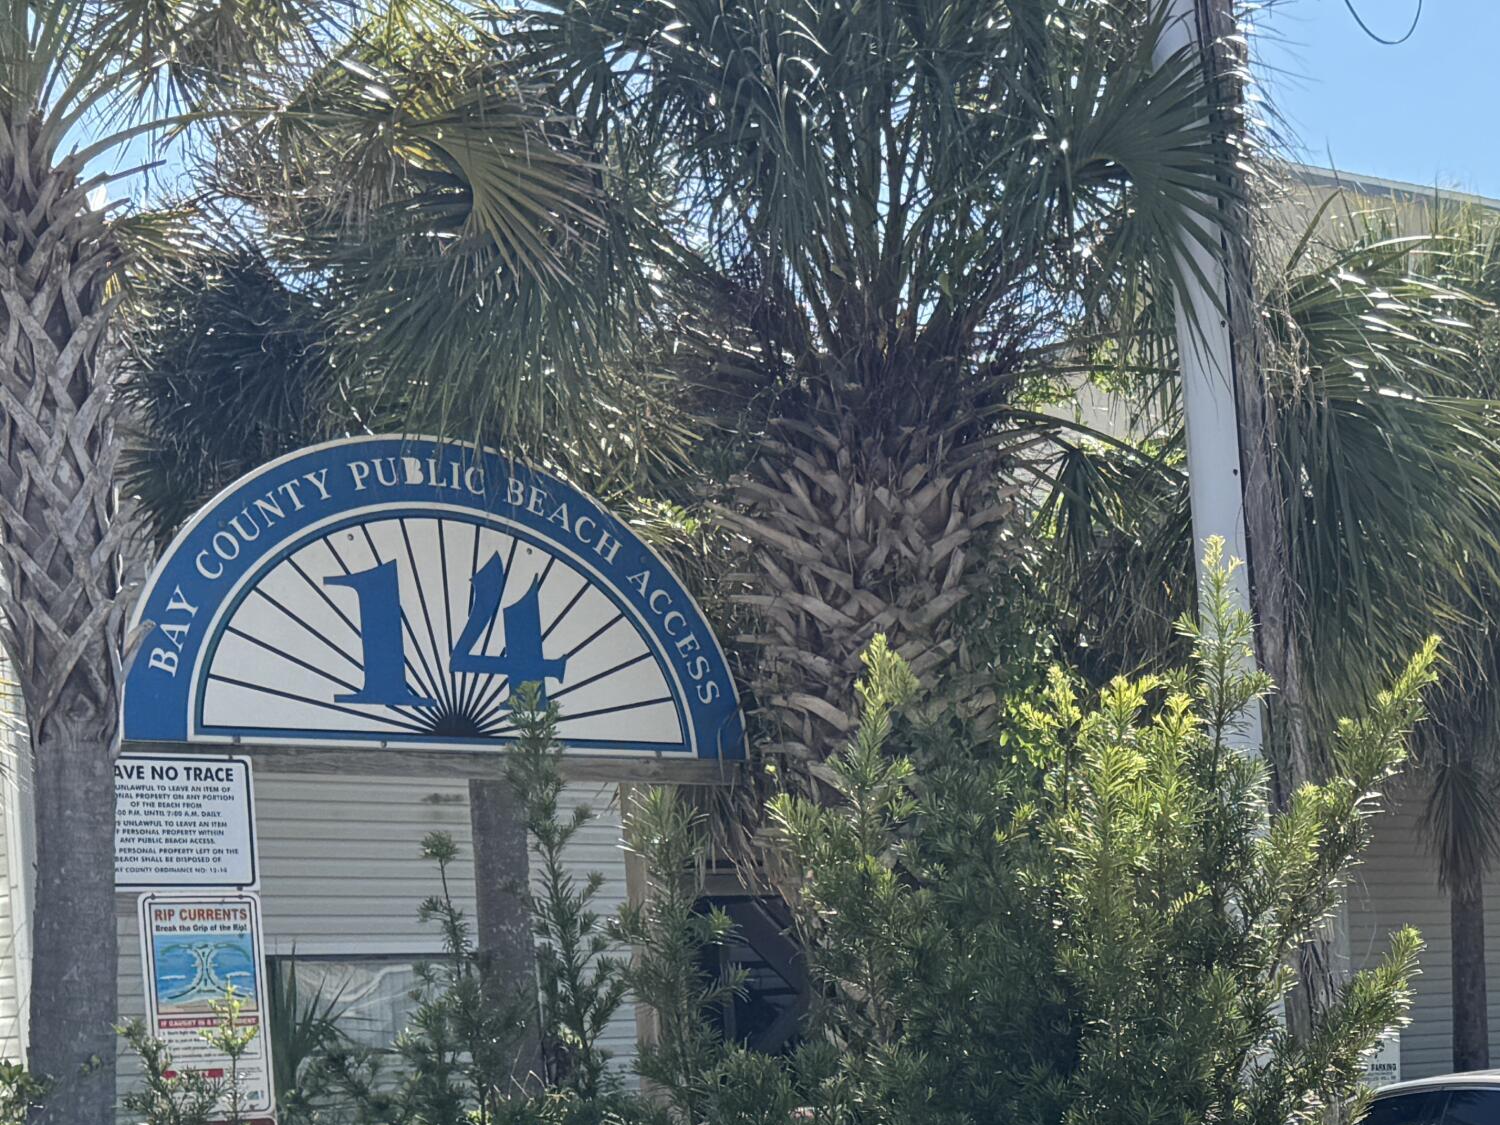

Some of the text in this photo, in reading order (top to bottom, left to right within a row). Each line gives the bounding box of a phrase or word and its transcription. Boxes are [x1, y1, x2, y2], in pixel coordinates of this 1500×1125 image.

[148, 457, 720, 705] BAY COUNTY PUBLIC BEACH ACCESS
[323, 549, 568, 710] 14
[114, 765, 234, 782] AVE NO TRACE
[154, 908, 248, 921] RIP CURRENTS
[155, 923, 178, 932] Break
[179, 924, 191, 932] the
[192, 923, 208, 932] Grip
[219, 923, 231, 931] the
